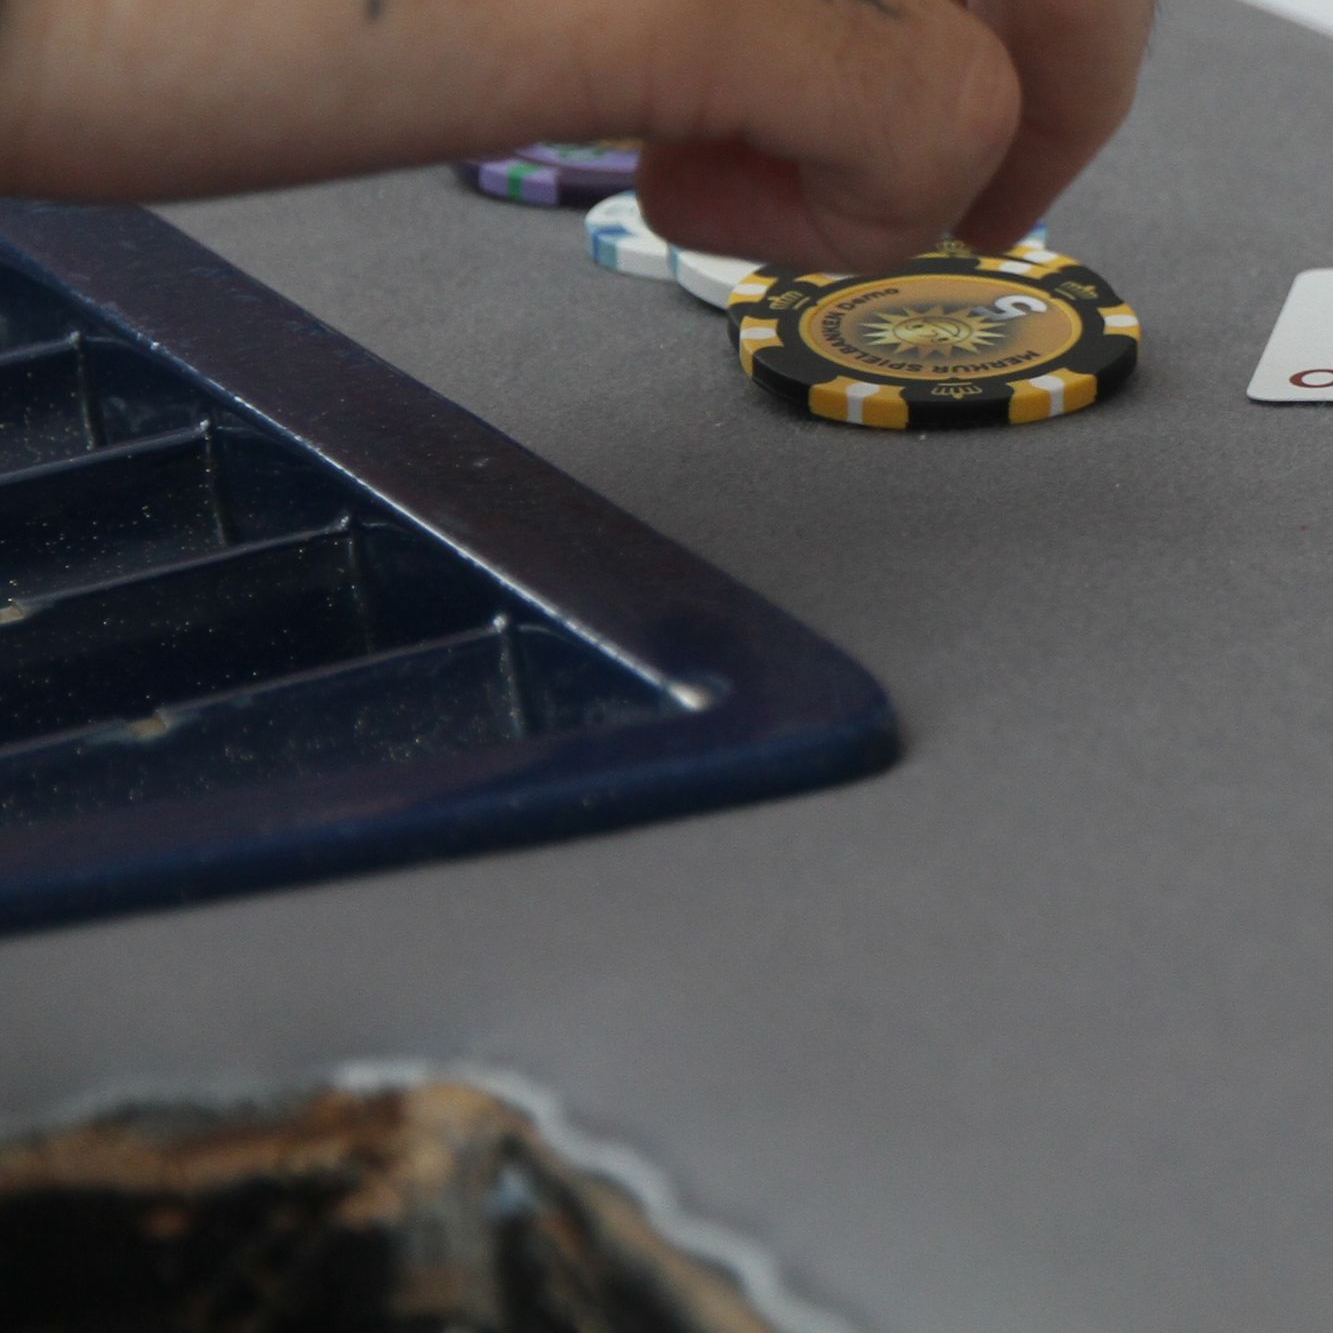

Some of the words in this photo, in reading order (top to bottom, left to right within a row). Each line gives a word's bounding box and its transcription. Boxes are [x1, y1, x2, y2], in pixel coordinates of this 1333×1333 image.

[842, 287, 900, 312] Demo
[972, 294, 1048, 320] 5
[820, 312, 923, 373] SPIELBANKEN
[930, 350, 1041, 375] MERKUR
